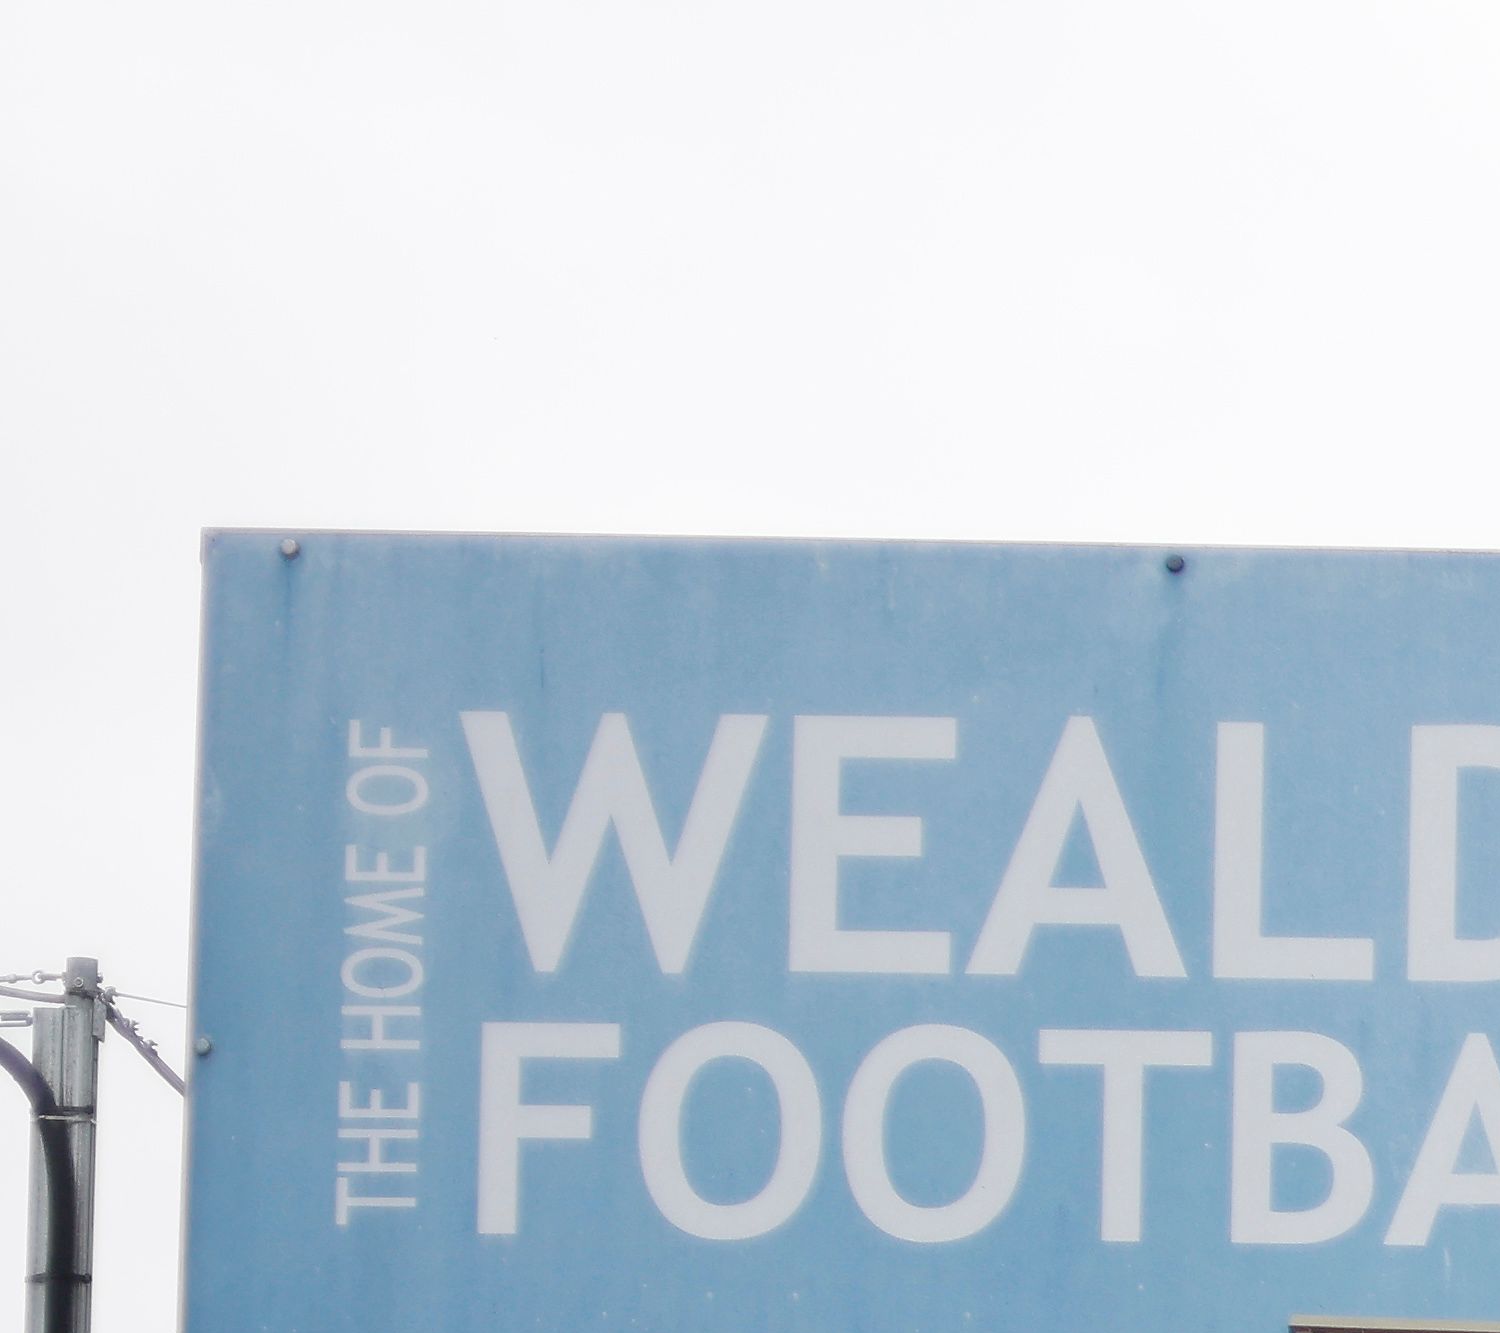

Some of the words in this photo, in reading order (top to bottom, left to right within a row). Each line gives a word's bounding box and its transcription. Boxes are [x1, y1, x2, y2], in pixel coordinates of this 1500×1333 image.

[346, 719, 429, 816] OF
[340, 844, 427, 1050] HOME
[336, 1081, 421, 1225] THE
